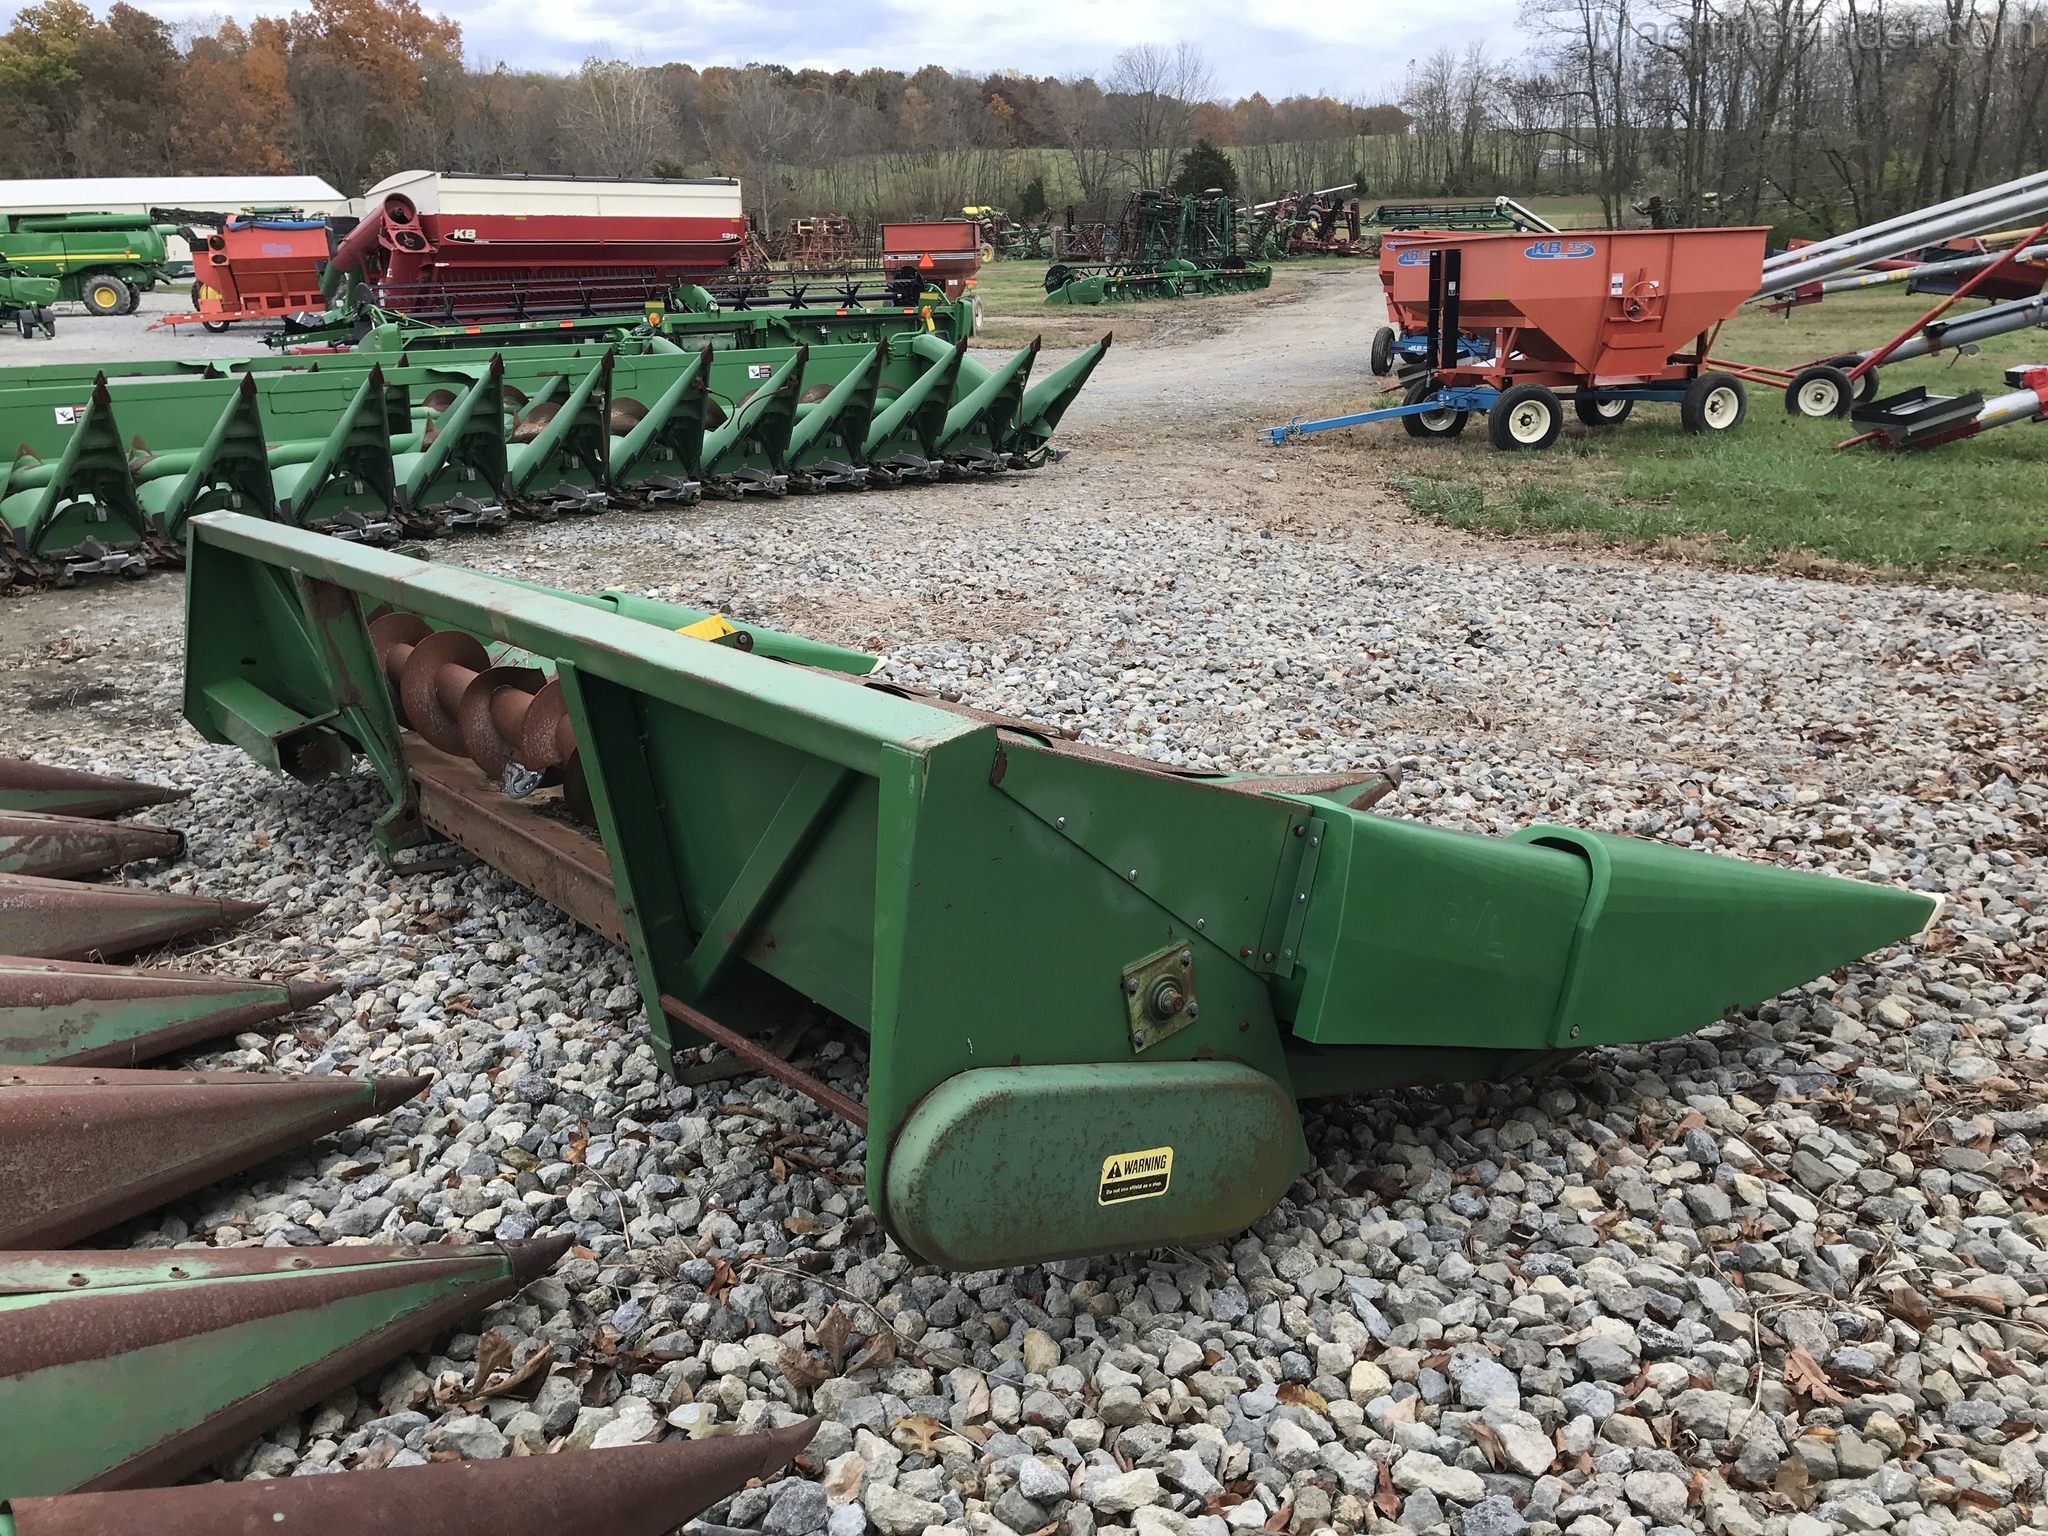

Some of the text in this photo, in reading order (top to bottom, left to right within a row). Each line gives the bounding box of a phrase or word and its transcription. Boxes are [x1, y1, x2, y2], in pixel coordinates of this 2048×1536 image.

[453, 229, 477, 239] KB
[1532, 241, 1561, 255] KB
[1124, 1154, 1167, 1175] WARNING
